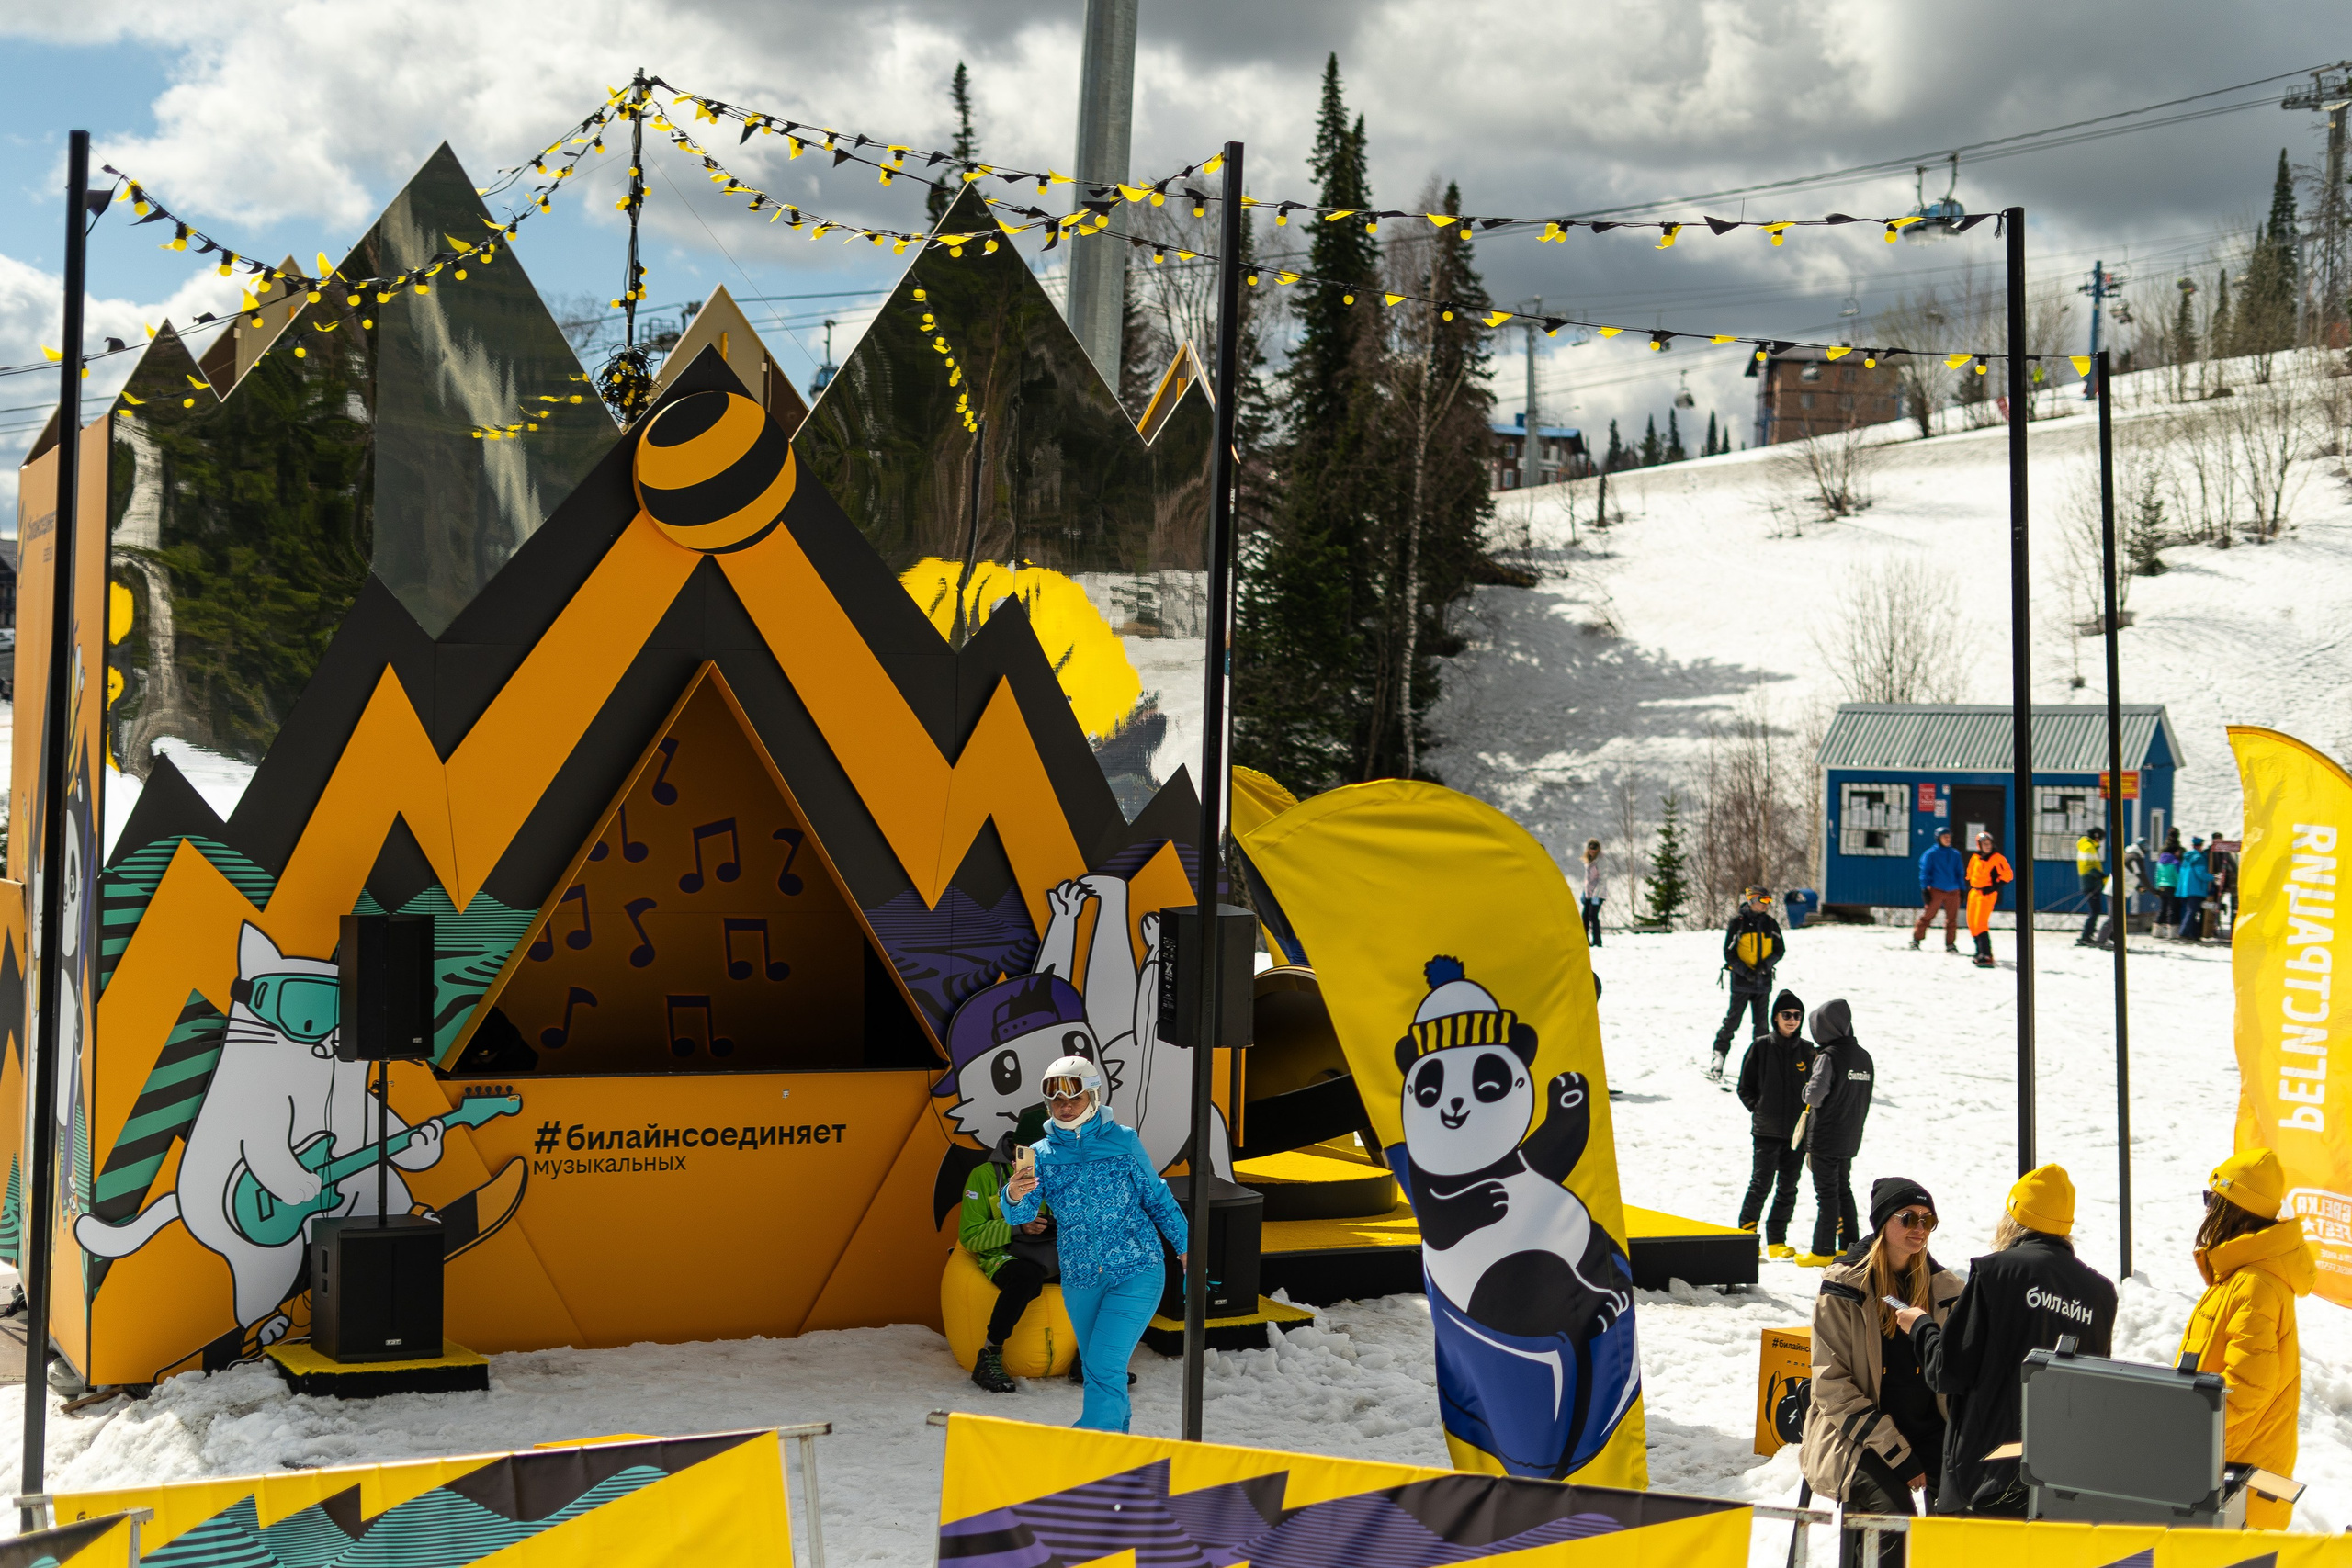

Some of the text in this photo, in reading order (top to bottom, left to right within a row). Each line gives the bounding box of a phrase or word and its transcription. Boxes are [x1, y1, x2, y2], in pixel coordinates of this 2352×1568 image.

[534, 1120, 847, 1154] #билайнсоединяет
[533, 1156, 687, 1180] музыкальных
[2026, 1286, 2093, 1325] билайн
[1771, 1338, 1811, 1352] #билайнс
